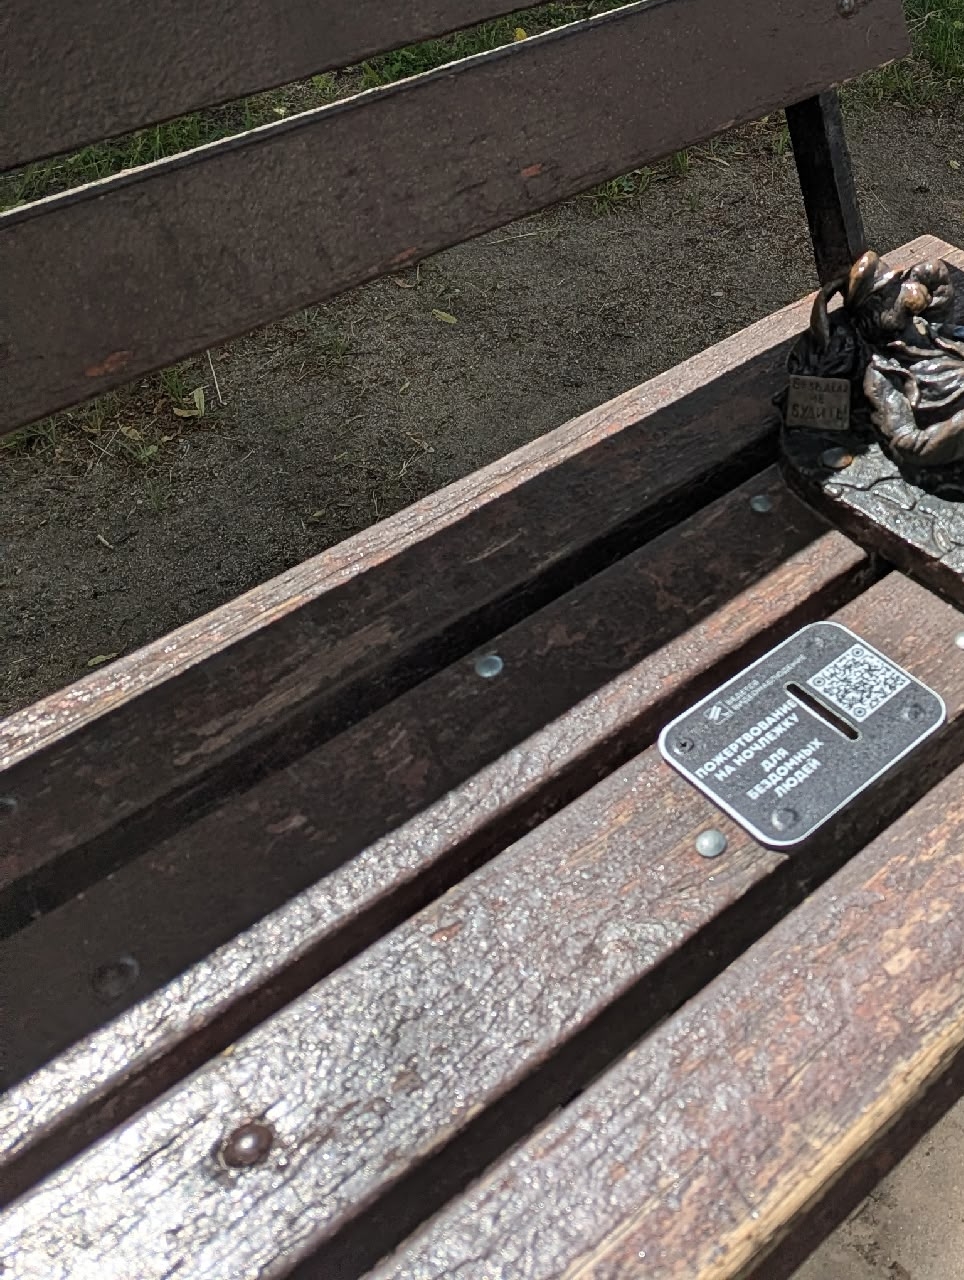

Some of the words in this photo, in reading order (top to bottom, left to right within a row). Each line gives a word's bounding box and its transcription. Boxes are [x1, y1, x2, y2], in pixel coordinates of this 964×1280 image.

[695, 699, 797, 779] ПОЖЕРТВОВАНИЕ
[714, 764, 737, 781] НА
[732, 713, 799, 766] НОЧЛЕЖКУ
[746, 738, 824, 799] БЕЗДОМНЫХ
[761, 747, 788, 772] ДЛЯ
[774, 758, 821, 797] ЛЮДЕЙ
